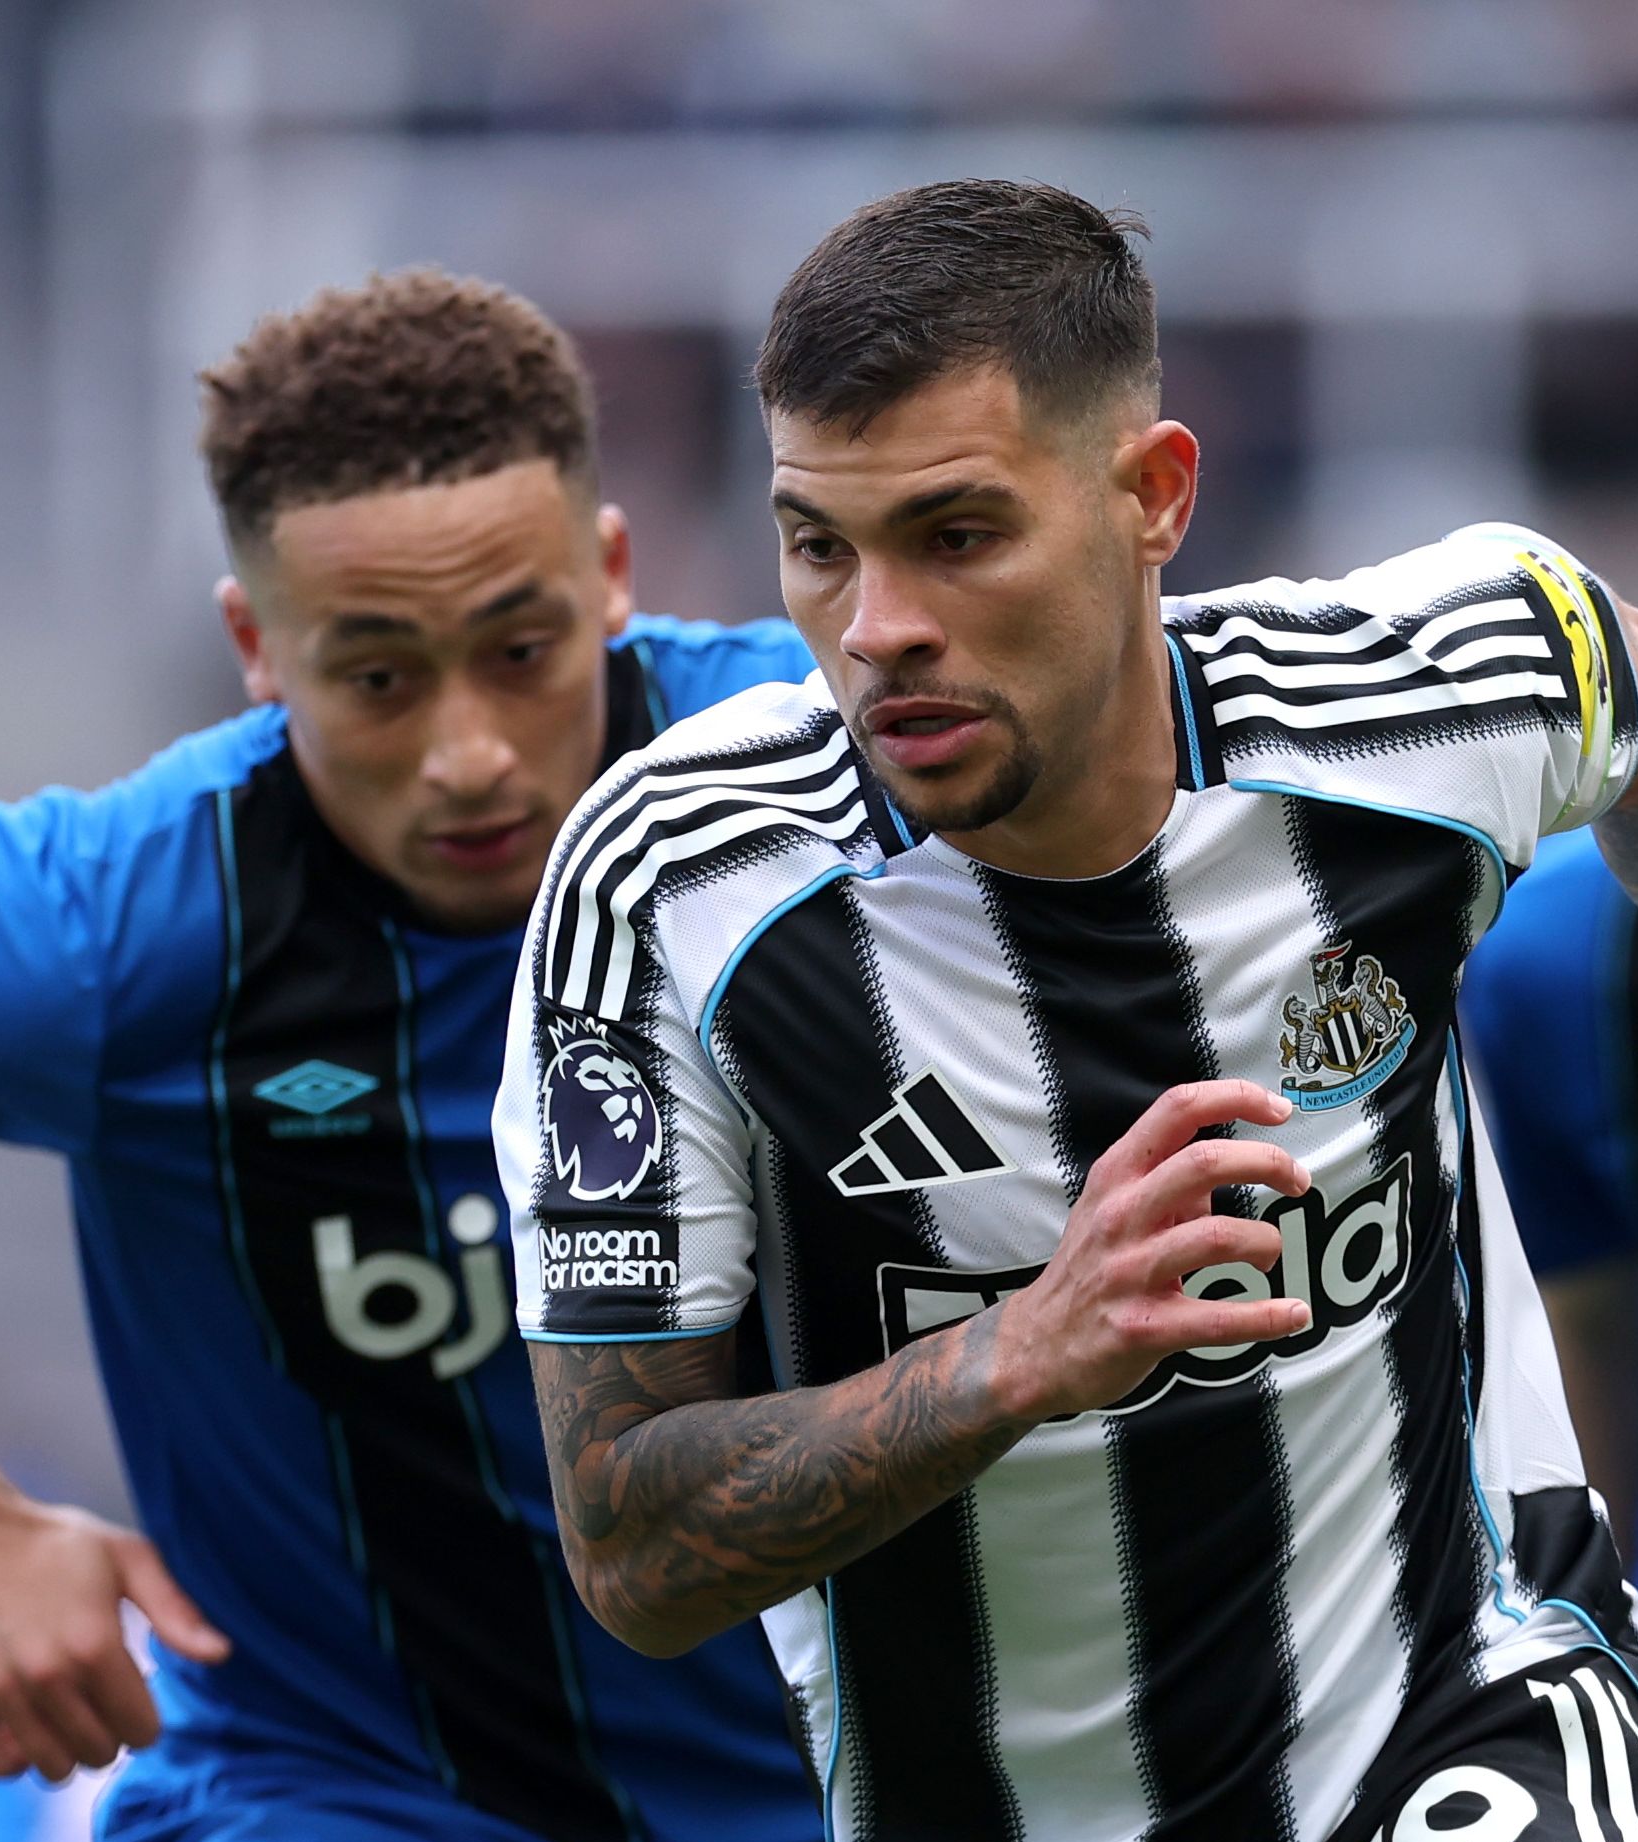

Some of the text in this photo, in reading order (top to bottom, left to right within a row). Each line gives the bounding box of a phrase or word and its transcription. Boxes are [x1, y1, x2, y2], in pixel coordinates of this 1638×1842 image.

[1305, 1048, 1402, 1107] NEWCASTLE UNITED
[539, 1227, 660, 1260] No room
[571, 1256, 678, 1288] racism
